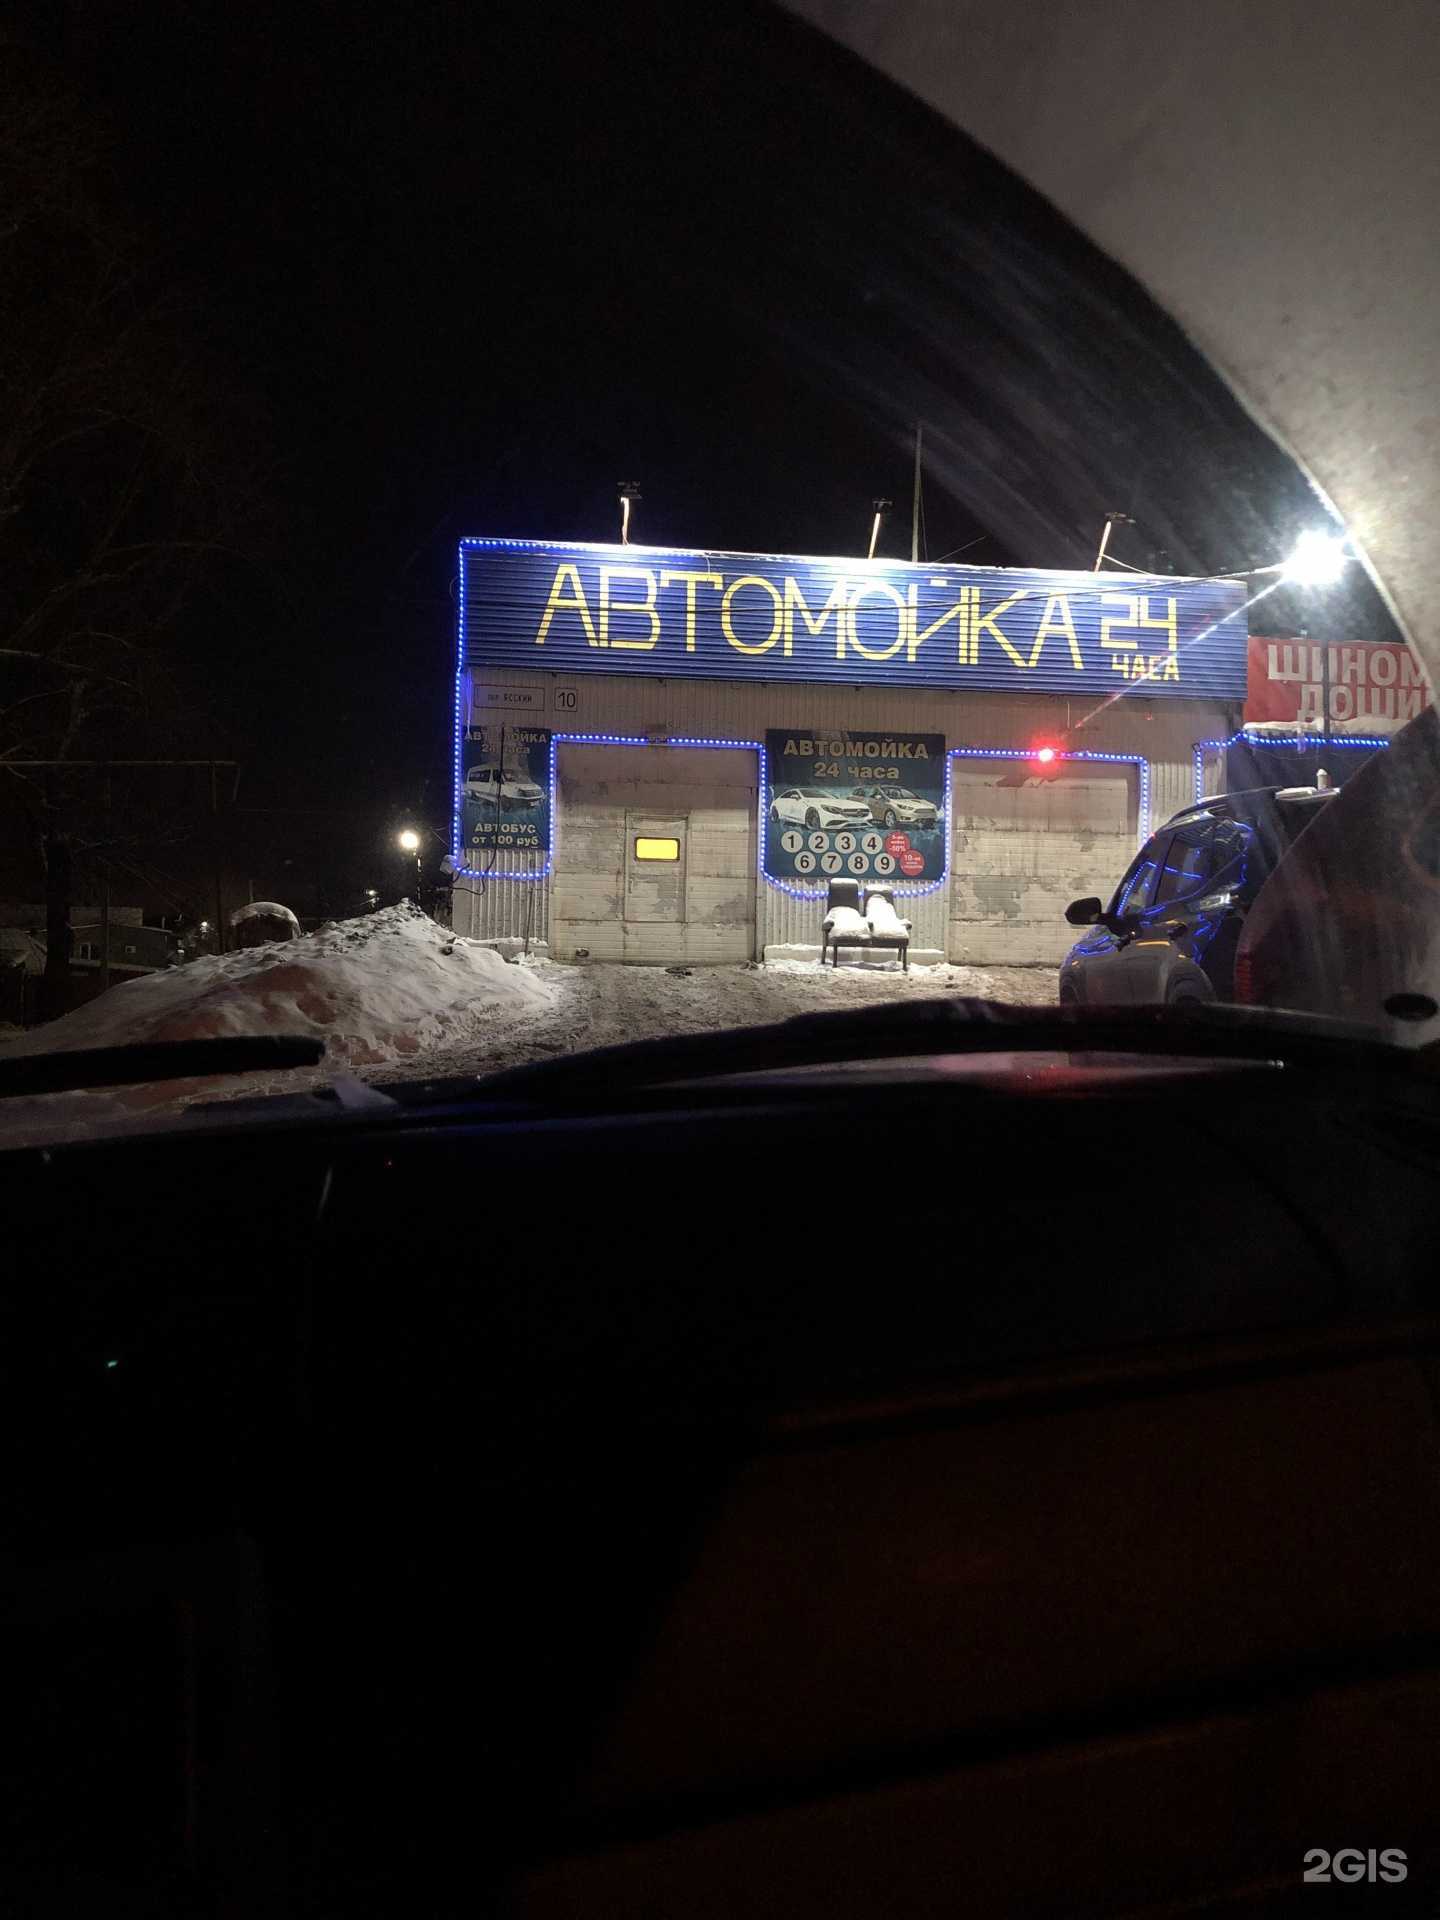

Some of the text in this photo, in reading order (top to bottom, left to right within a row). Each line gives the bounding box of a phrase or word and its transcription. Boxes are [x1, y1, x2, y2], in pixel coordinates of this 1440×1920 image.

[535, 564, 1177, 669] АВТОМОЙКА 24
[558, 692, 576, 708] 10
[1297, 683, 1432, 722] ДОШИ
[783, 739, 929, 759] АВТОМОЙКА
[814, 762, 900, 779] 24 часа
[474, 823, 536, 834] АВТОБУС
[787, 834, 877, 850] 1 2 3 4
[799, 854, 890, 870] 6 7 8 9
